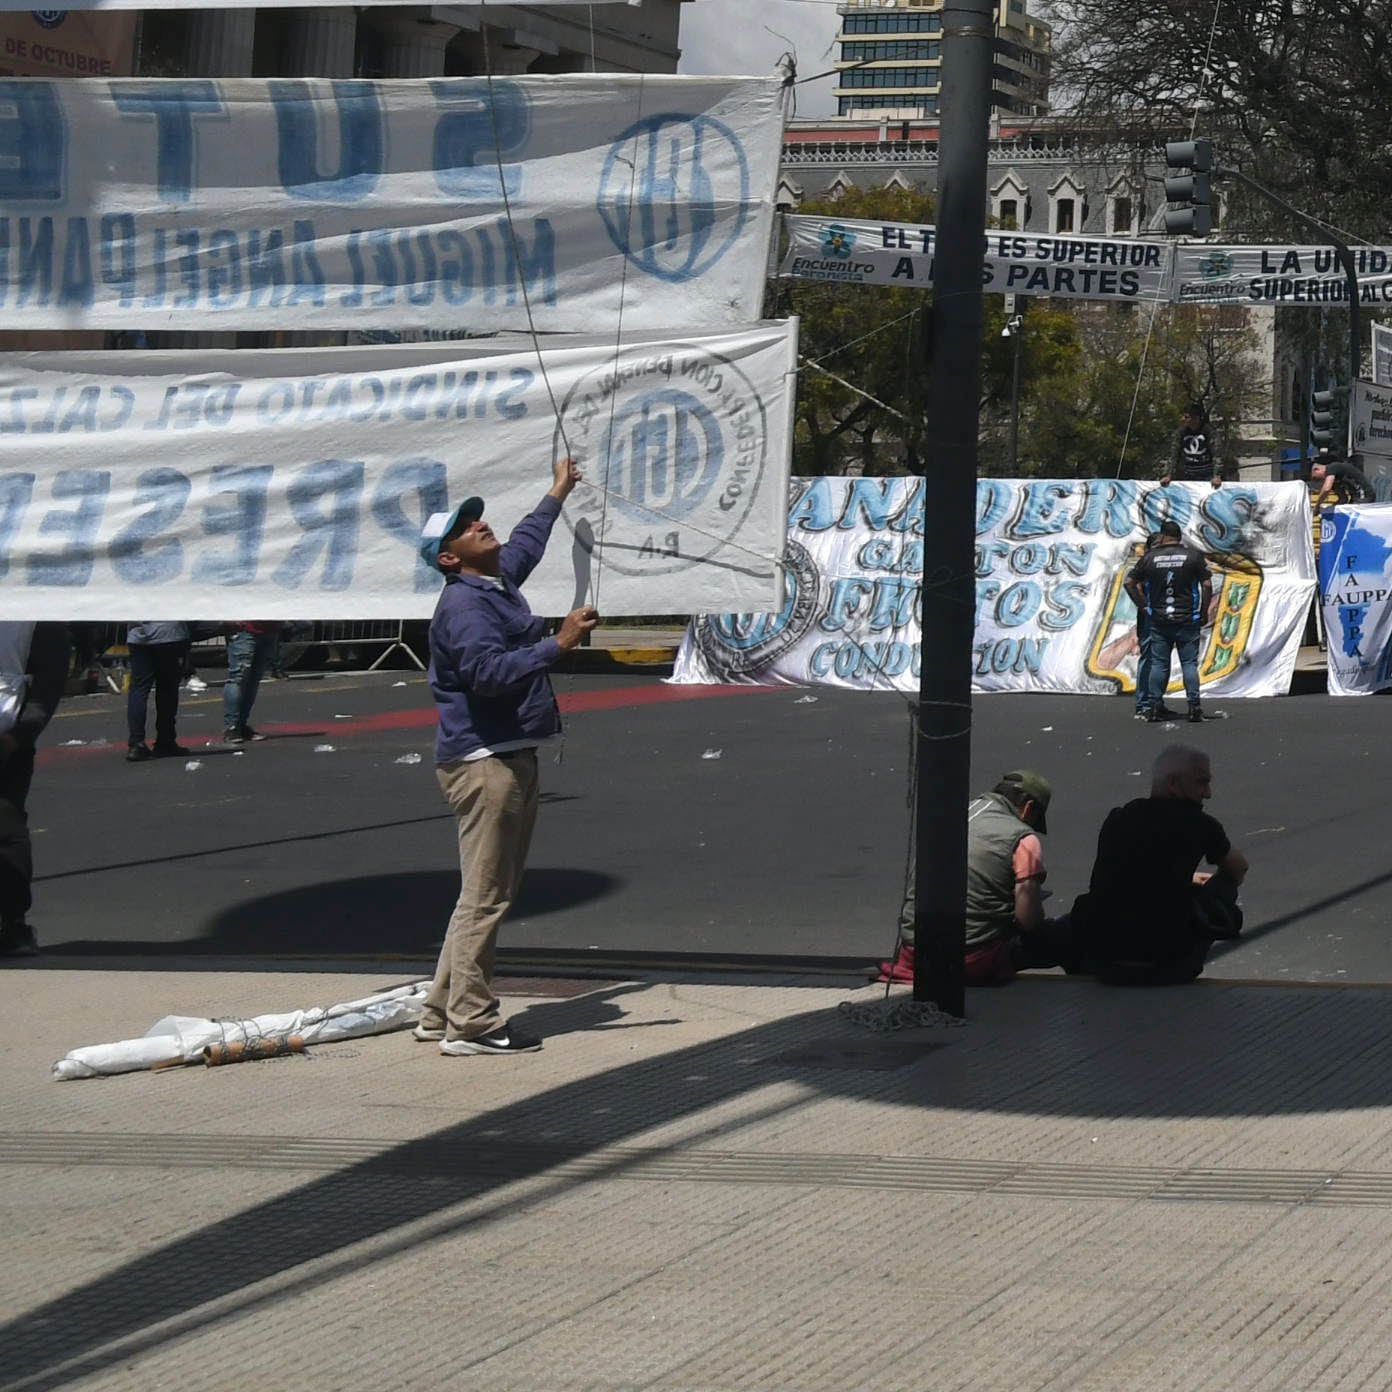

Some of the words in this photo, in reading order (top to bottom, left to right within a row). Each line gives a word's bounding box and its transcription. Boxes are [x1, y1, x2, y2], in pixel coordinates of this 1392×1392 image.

[4, 37, 27, 57] DE
[30, 44, 111, 75] OCTUBRE
[793, 256, 875, 275] Encuentro
[882, 226, 911, 250] EL
[999, 236, 1027, 259] ES
[1035, 237, 1161, 268] SUPERIOR
[1261, 251, 1302, 275] LA
[891, 256, 914, 279] A
[1006, 263, 1141, 296] PARTES
[1178, 283, 1246, 296] Encuentro
[1361, 283, 1380, 302] AL
[788, 476, 1260, 554] ANADEROS
[857, 538, 1099, 578] GATON
